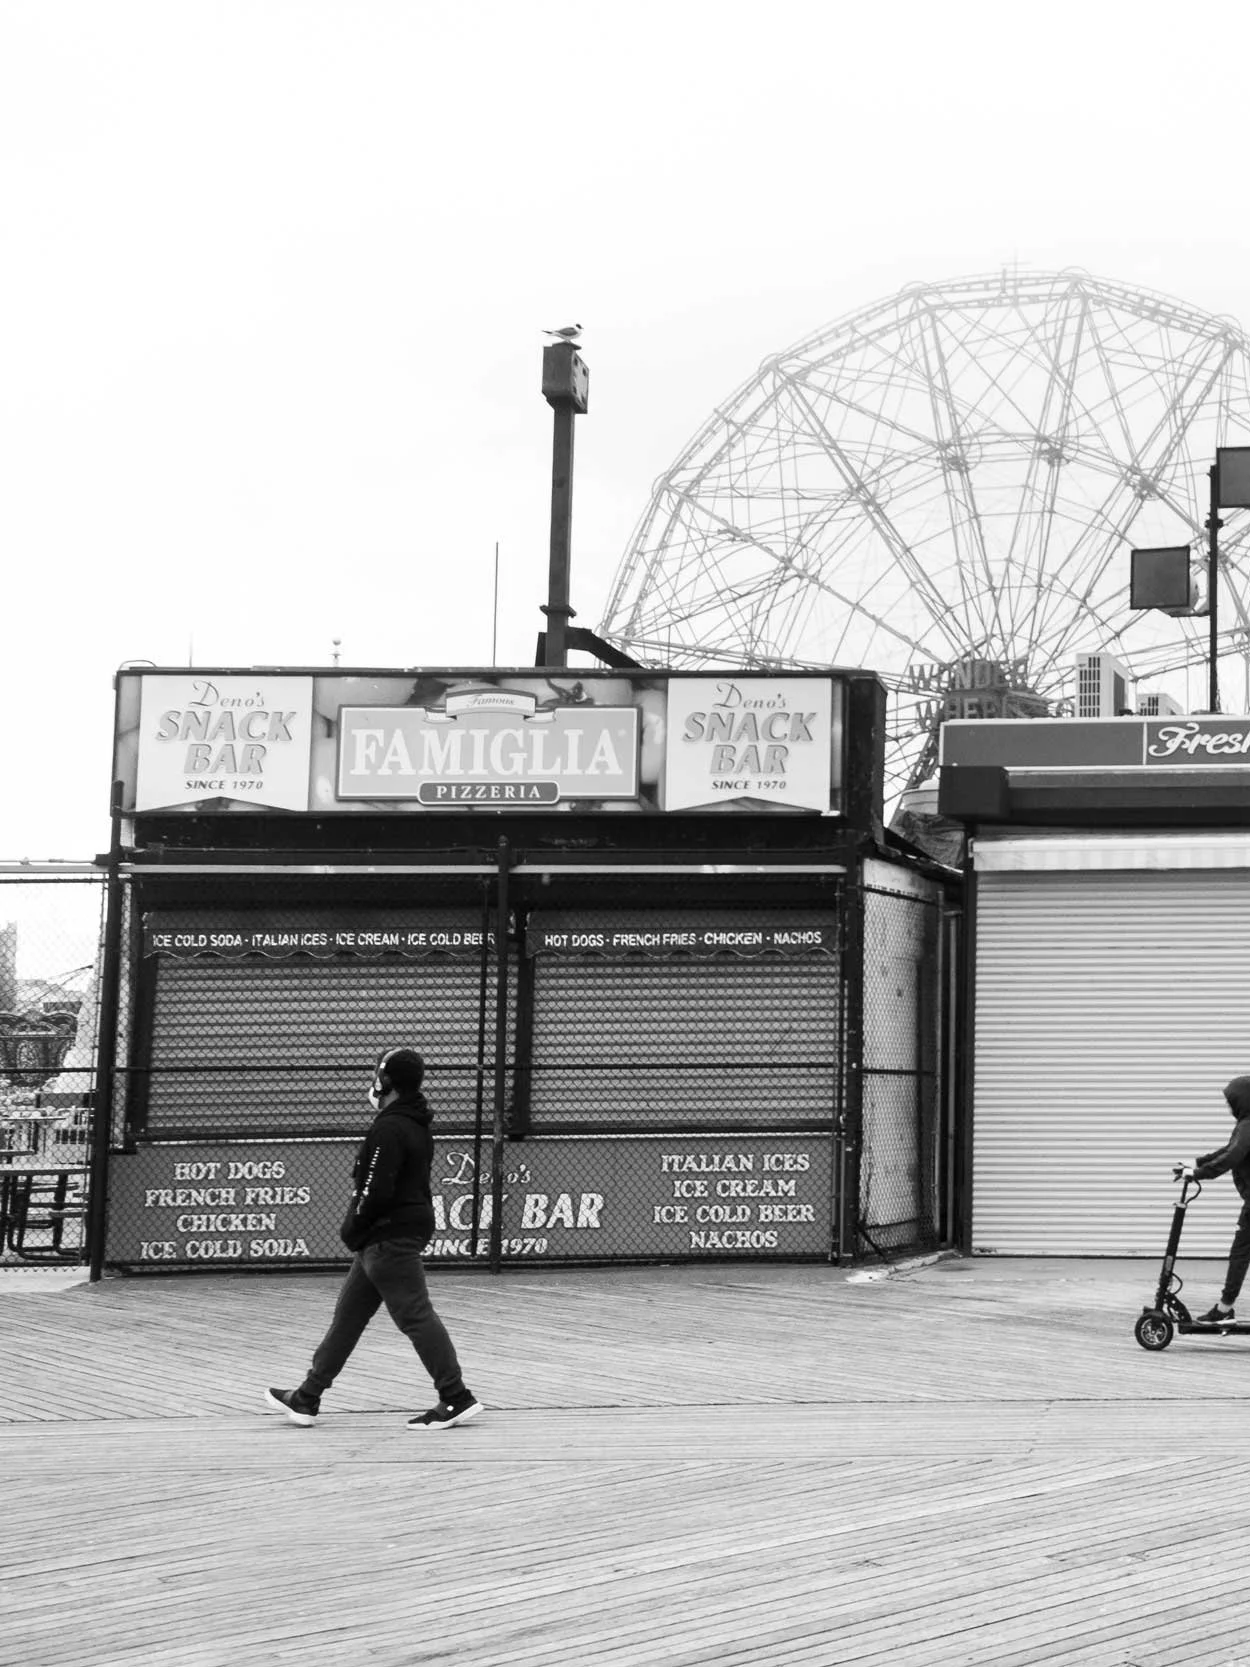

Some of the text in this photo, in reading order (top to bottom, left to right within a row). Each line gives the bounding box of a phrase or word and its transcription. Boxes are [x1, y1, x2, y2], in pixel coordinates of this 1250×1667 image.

[189, 680, 265, 707] Deno's
[712, 682, 787, 709] Deno's
[155, 710, 297, 742] SNACK
[682, 712, 818, 743] SNACK
[183, 743, 267, 775] BAR
[350, 728, 623, 776] FAMIGLIA
[710, 744, 789, 775] BAR
[185, 780, 264, 790] SINCE 1970
[436, 785, 541, 799] PIZZERIA
[712, 780, 787, 790] SINCE 1970
[153, 934, 172, 947] ICE
[175, 934, 207, 947] COLD
[210, 934, 243, 947] SODA
[252, 933, 298, 947] ITALIAN
[301, 933, 327, 946] ICES
[336, 933, 355, 946] ICE
[358, 933, 399, 946] CREAM
[407, 933, 427, 946] ICE
[430, 933, 461, 946] COLD
[545, 931, 822, 947] HOT DOGS FRENCH FRIES CHICKEN NACHOS
[173, 1161, 286, 1180] HOT DOGS
[441, 1151, 531, 1185] Deo's
[661, 1153, 810, 1172] ITALIAN ICES
[145, 1187, 311, 1207] FRENCH FRIES
[673, 1179, 796, 1198] ICE CREAM
[521, 1193, 604, 1229] BAR
[653, 1204, 815, 1224] ICE COLD BEER
[176, 1213, 277, 1232] CHICKEN
[140, 1239, 310, 1259] ICE COLD SODA
[689, 1230, 778, 1249] NACHOS
